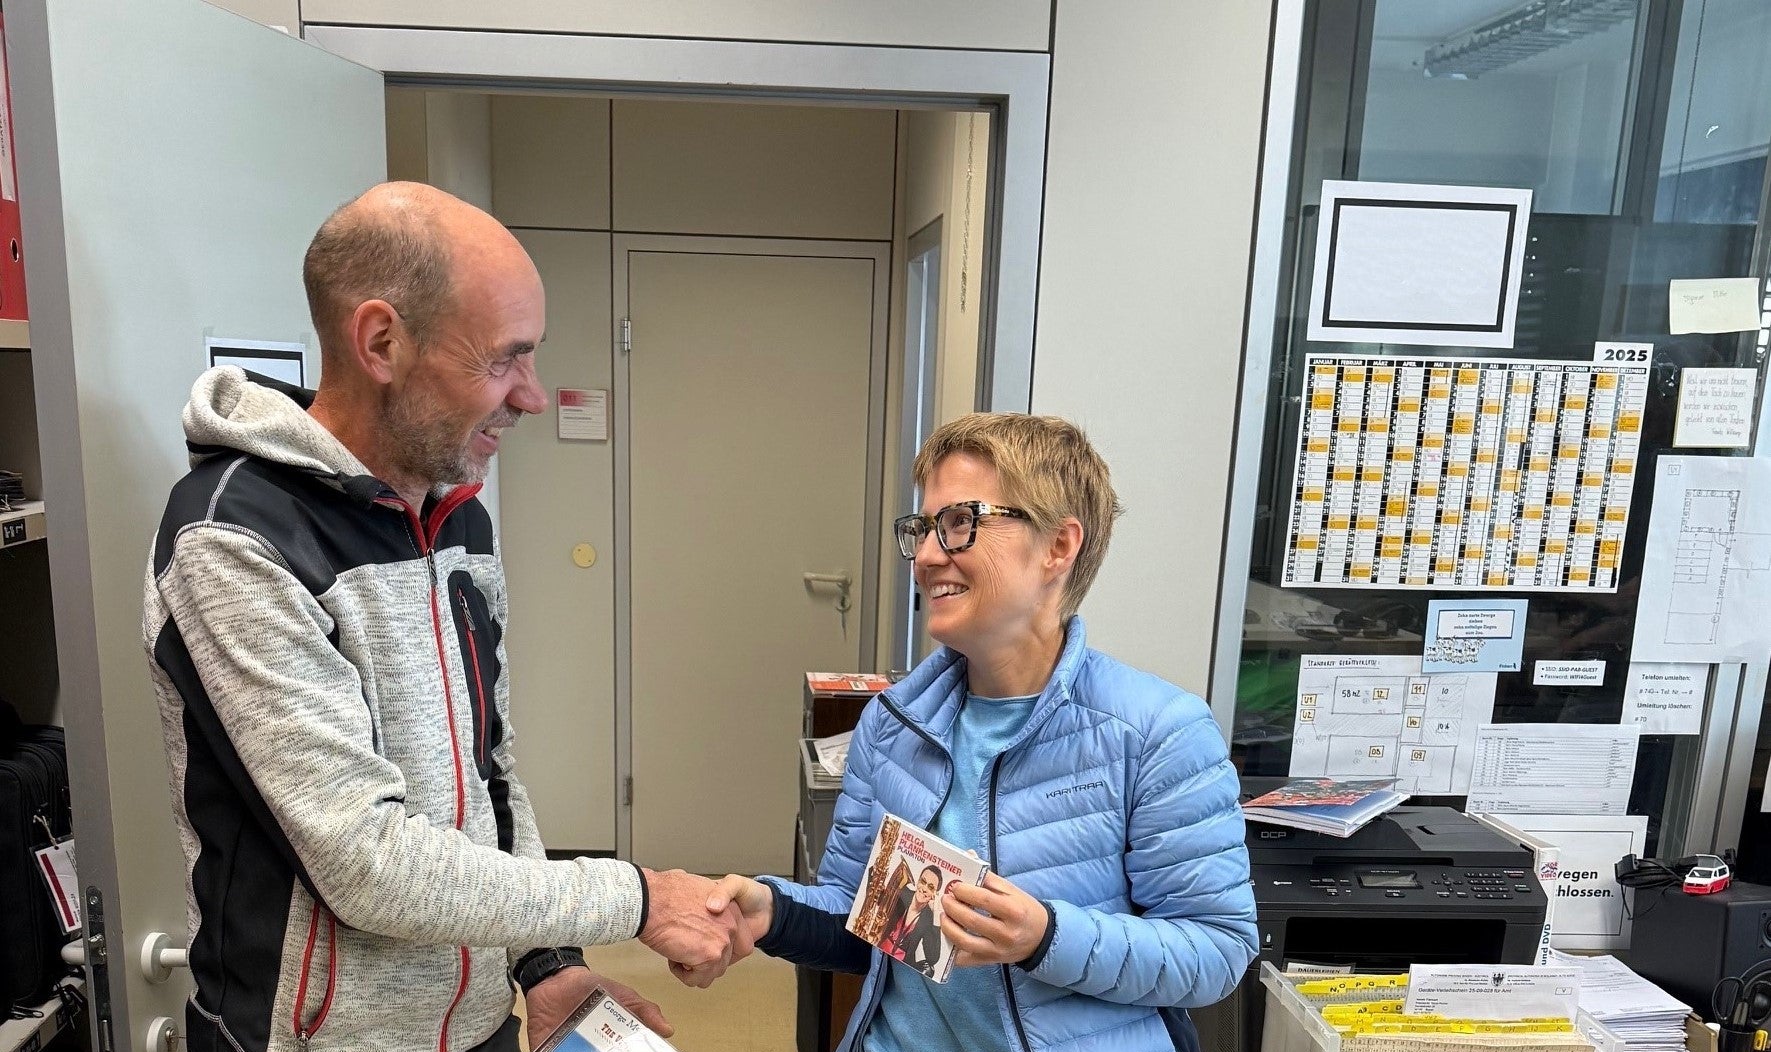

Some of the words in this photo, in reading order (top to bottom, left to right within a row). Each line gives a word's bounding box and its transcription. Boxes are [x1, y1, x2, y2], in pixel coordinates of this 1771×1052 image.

[1604, 348, 1648, 361] 2025
[1342, 689, 1351, 698] 58
[1414, 685, 1423, 693] 11
[1637, 702, 1667, 710] Umleitung
[1668, 702, 1692, 710] löschen:
[1302, 711, 1314, 719] U2
[1045, 787, 1072, 799] KARI
[1072, 781, 1104, 794] TRAA
[902, 830, 925, 848] HELGA
[1260, 831, 1287, 839] DCP
[897, 845, 927, 864] PLANKTON
[899, 838, 963, 876] PLANKENSTEINER
[1556, 885, 1614, 897] hlossen.
[1542, 923, 1551, 944] DVD
[1541, 947, 1549, 966] und
[603, 1000, 627, 1024] George
[601, 1023, 615, 1039] THE
